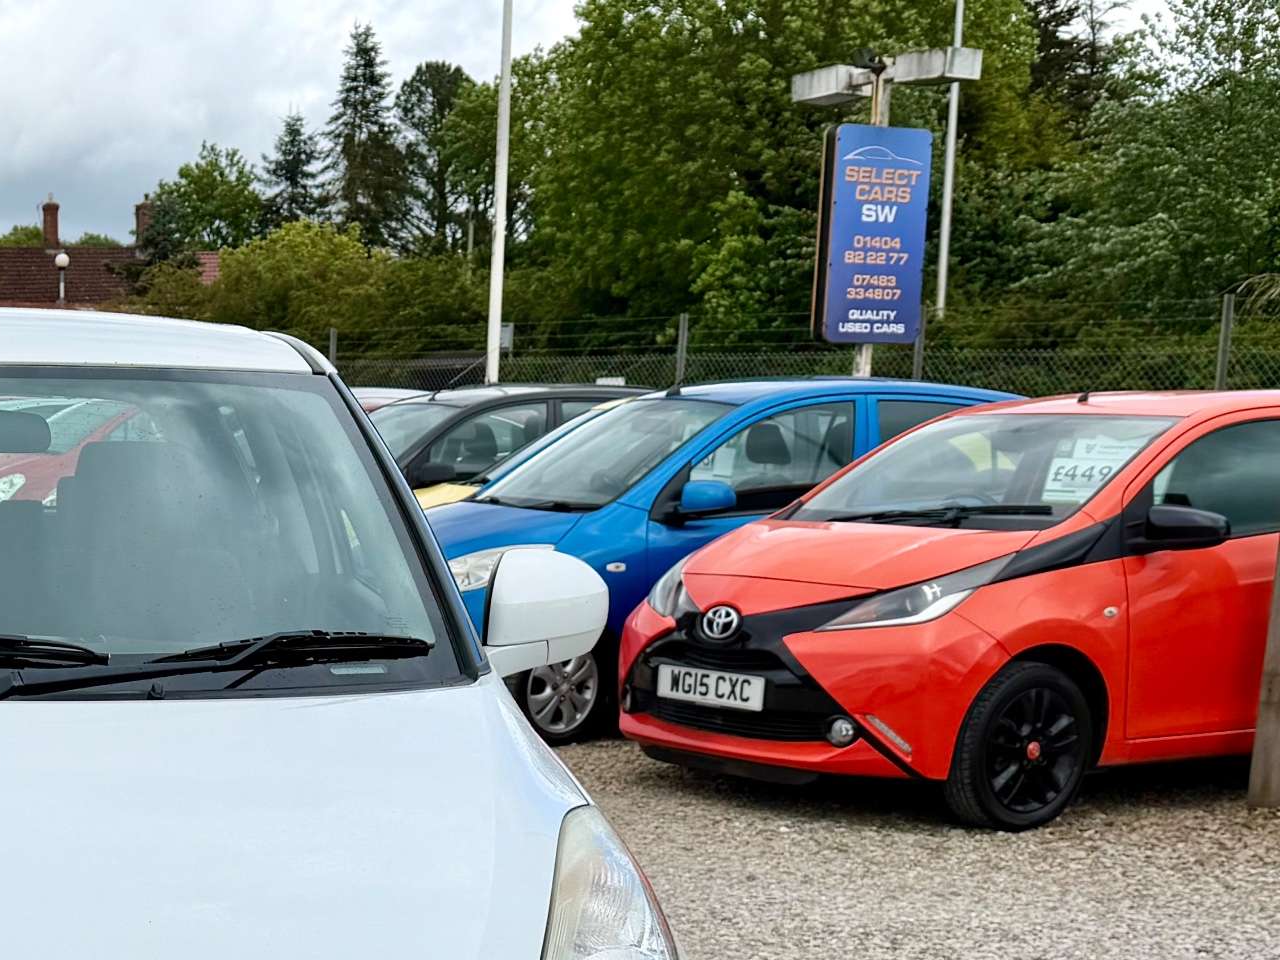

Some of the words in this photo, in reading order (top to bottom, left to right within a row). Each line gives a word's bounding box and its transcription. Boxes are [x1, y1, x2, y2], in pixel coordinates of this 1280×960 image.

[845, 165, 922, 185] SELECT
[855, 184, 911, 203] CARS
[861, 203, 898, 223] SW
[853, 234, 902, 250] 01404
[853, 274, 897, 287] 07483
[848, 308, 897, 321] QUALITY
[838, 321, 871, 333] USED
[872, 322, 906, 334] CARS
[670, 669, 711, 697] WG15
[714, 675, 752, 703] CXC
